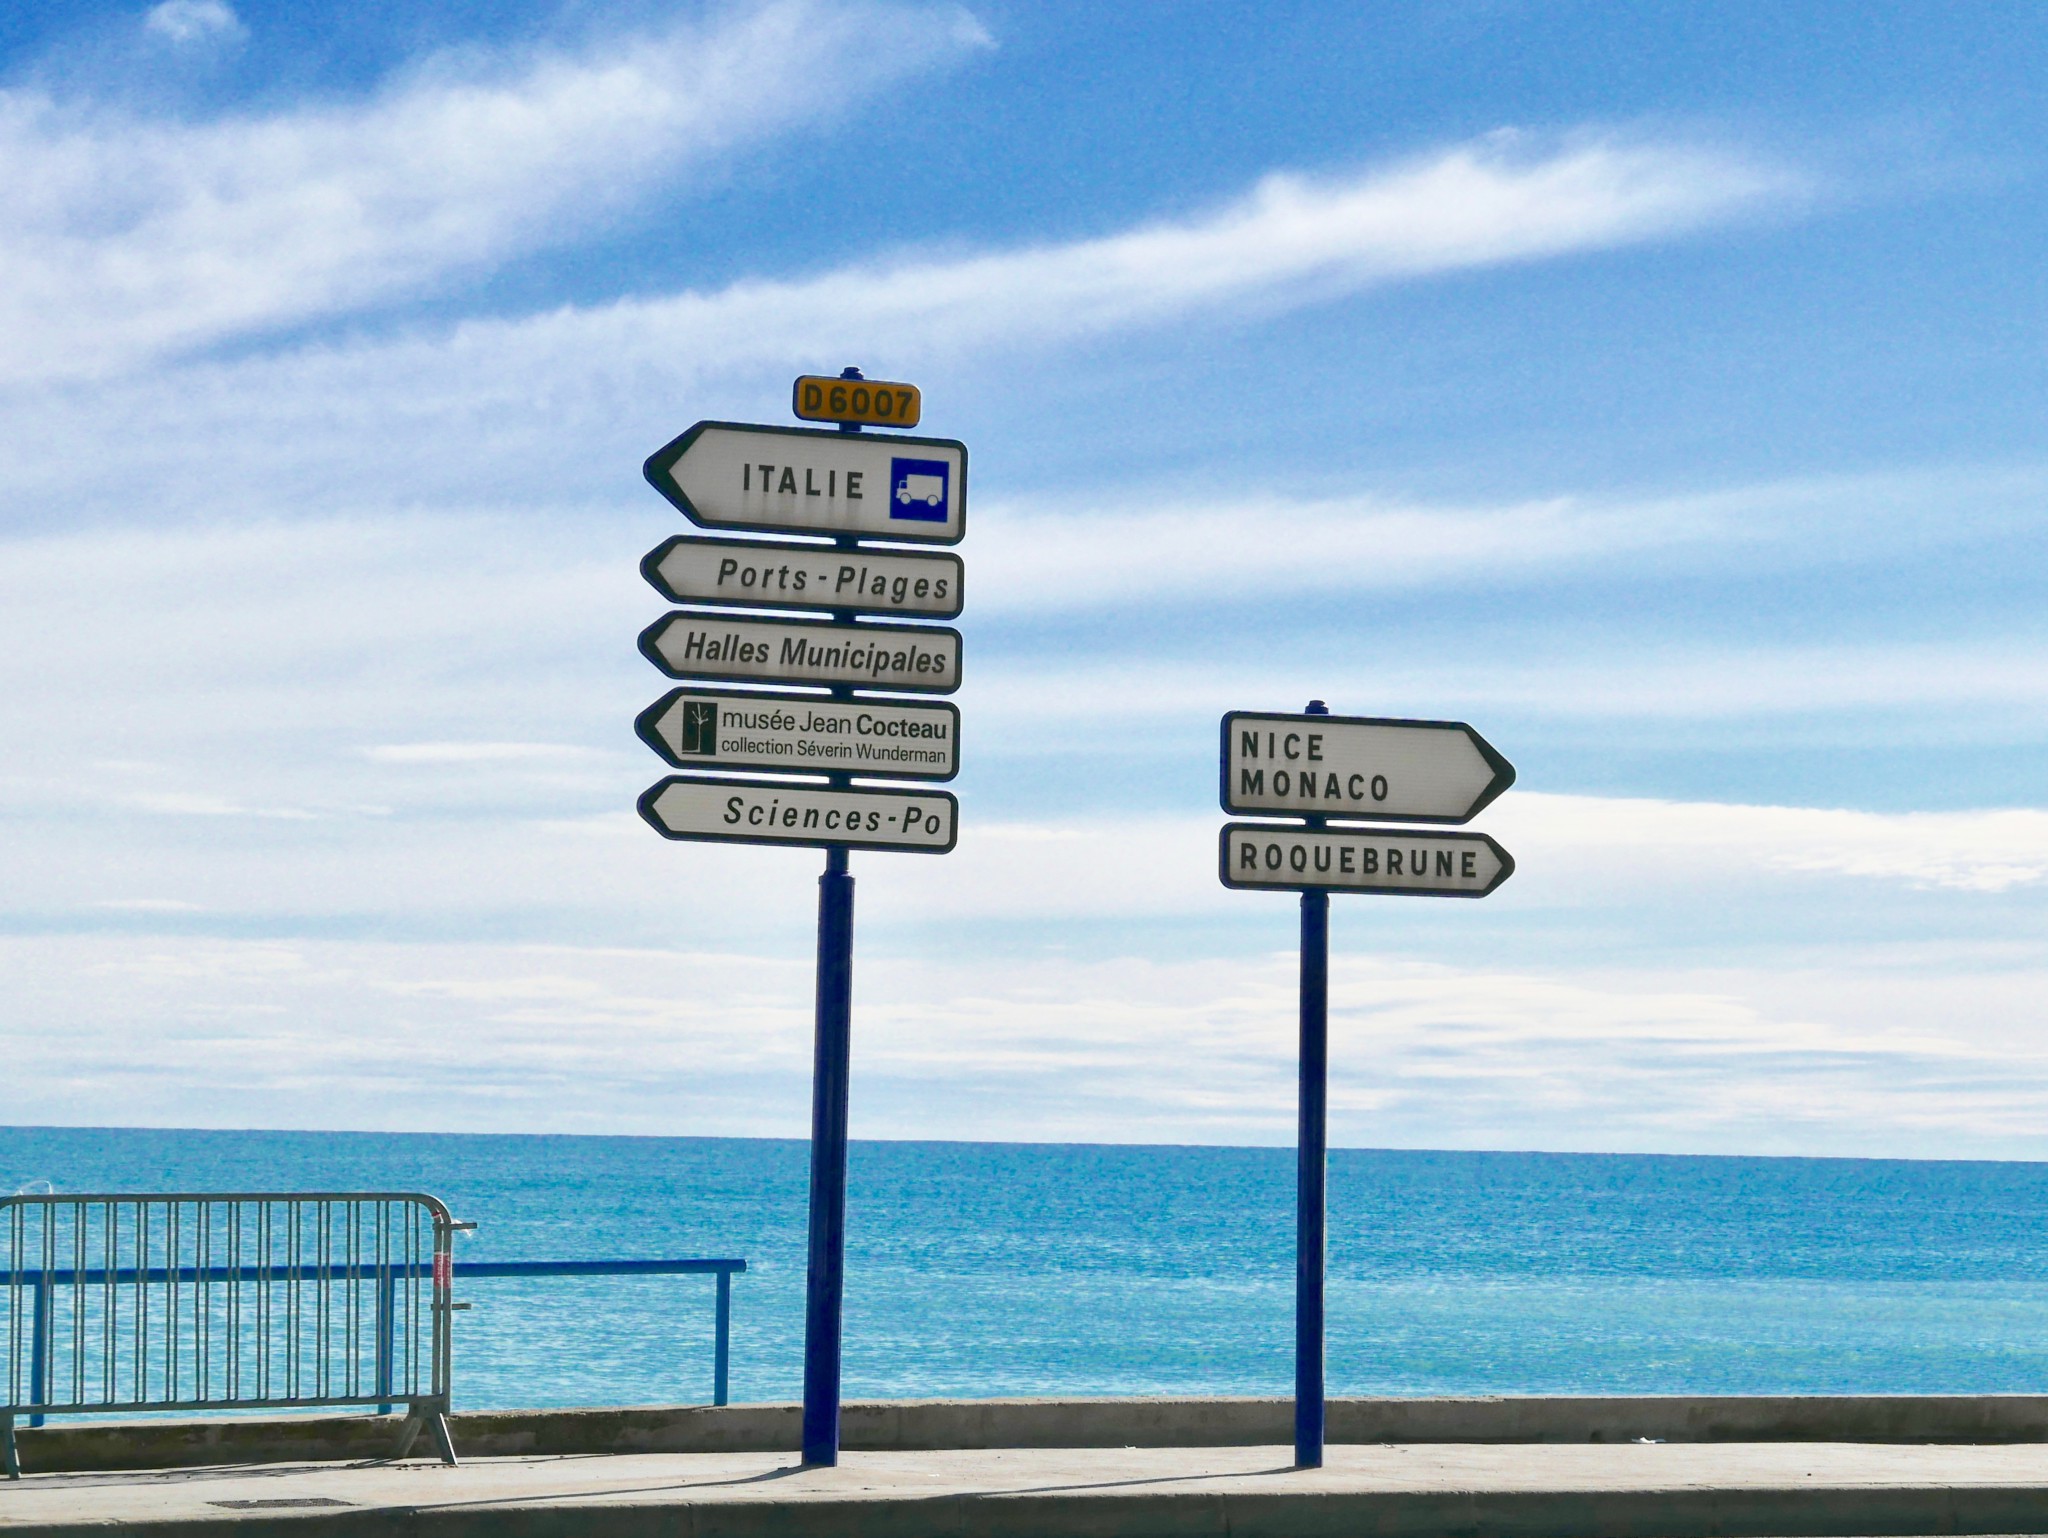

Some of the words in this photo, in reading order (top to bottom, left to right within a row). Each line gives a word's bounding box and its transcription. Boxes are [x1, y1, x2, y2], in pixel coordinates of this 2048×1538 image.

[743, 463, 864, 500] ITALIE
[717, 558, 807, 591] Ports
[835, 565, 949, 604] Plages
[684, 631, 770, 664] Halles
[779, 637, 947, 677] Municipales
[722, 709, 795, 731] musée
[799, 711, 851, 734] Jean
[856, 713, 947, 739] Cocteau
[721, 736, 793, 755] collection
[797, 739, 852, 758] Séverin
[855, 743, 946, 763] Wunderman
[1241, 731, 1324, 761] NICE
[1240, 768, 1389, 801] MONACO
[723, 796, 942, 835] Sciences-Po
[1240, 842, 1477, 878] ROQUEBRUNE
